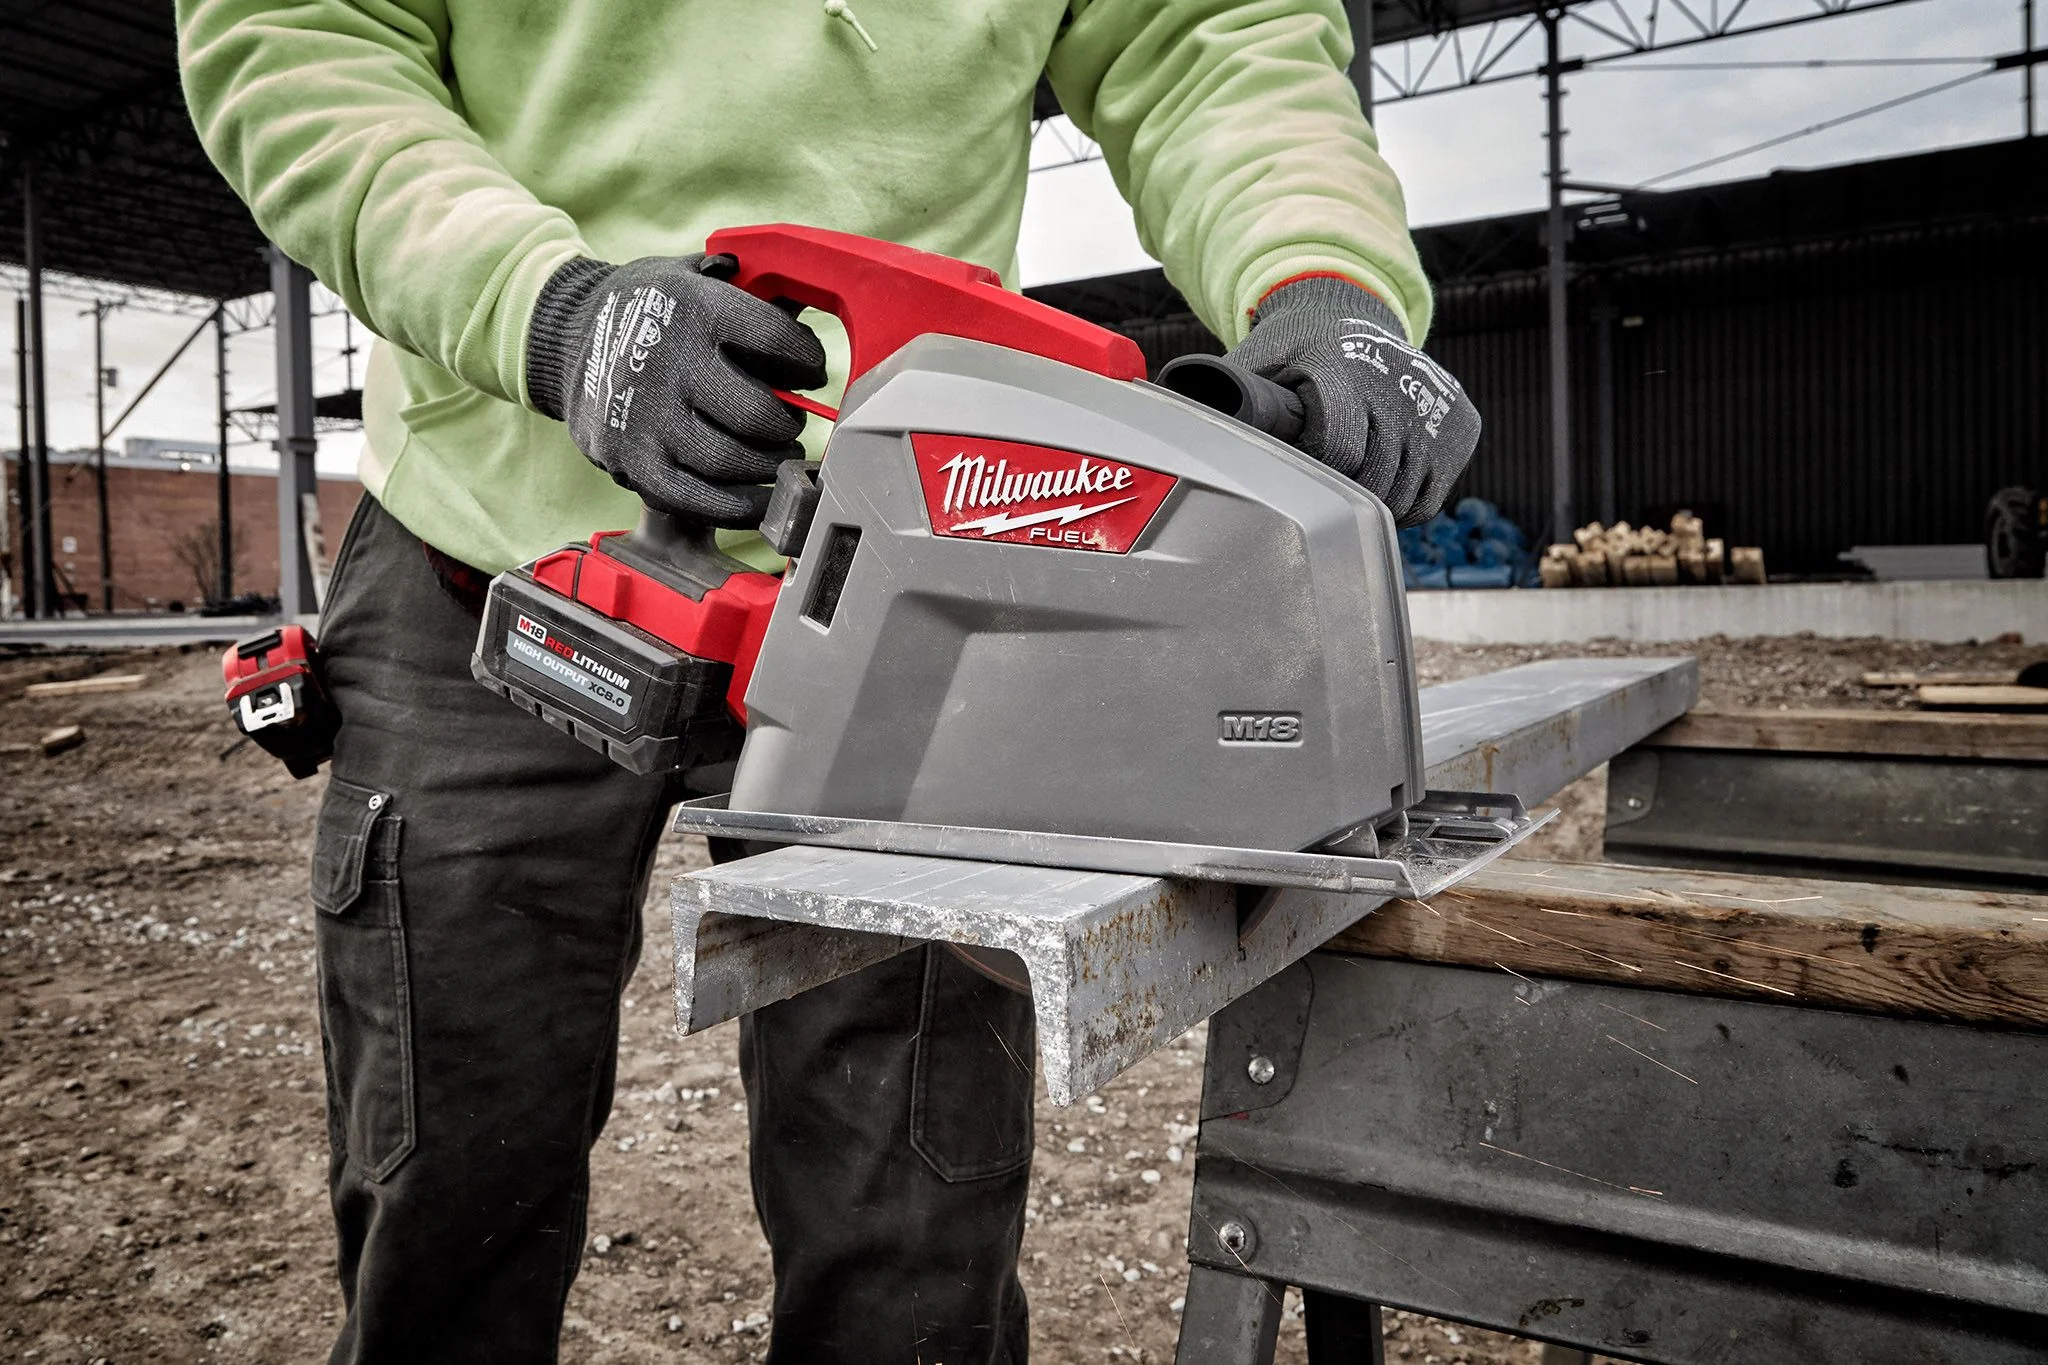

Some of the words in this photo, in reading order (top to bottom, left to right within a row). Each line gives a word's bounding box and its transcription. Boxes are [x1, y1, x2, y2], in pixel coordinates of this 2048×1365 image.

[937, 452, 1134, 515] Milwaukee
[1029, 526, 1097, 545] FUEL
[519, 617, 546, 640] M18
[513, 638, 542, 661] HIGH
[542, 655, 589, 687] OUTPUT
[587, 681, 626, 708] XC8.0
[1223, 715, 1300, 742] M18
